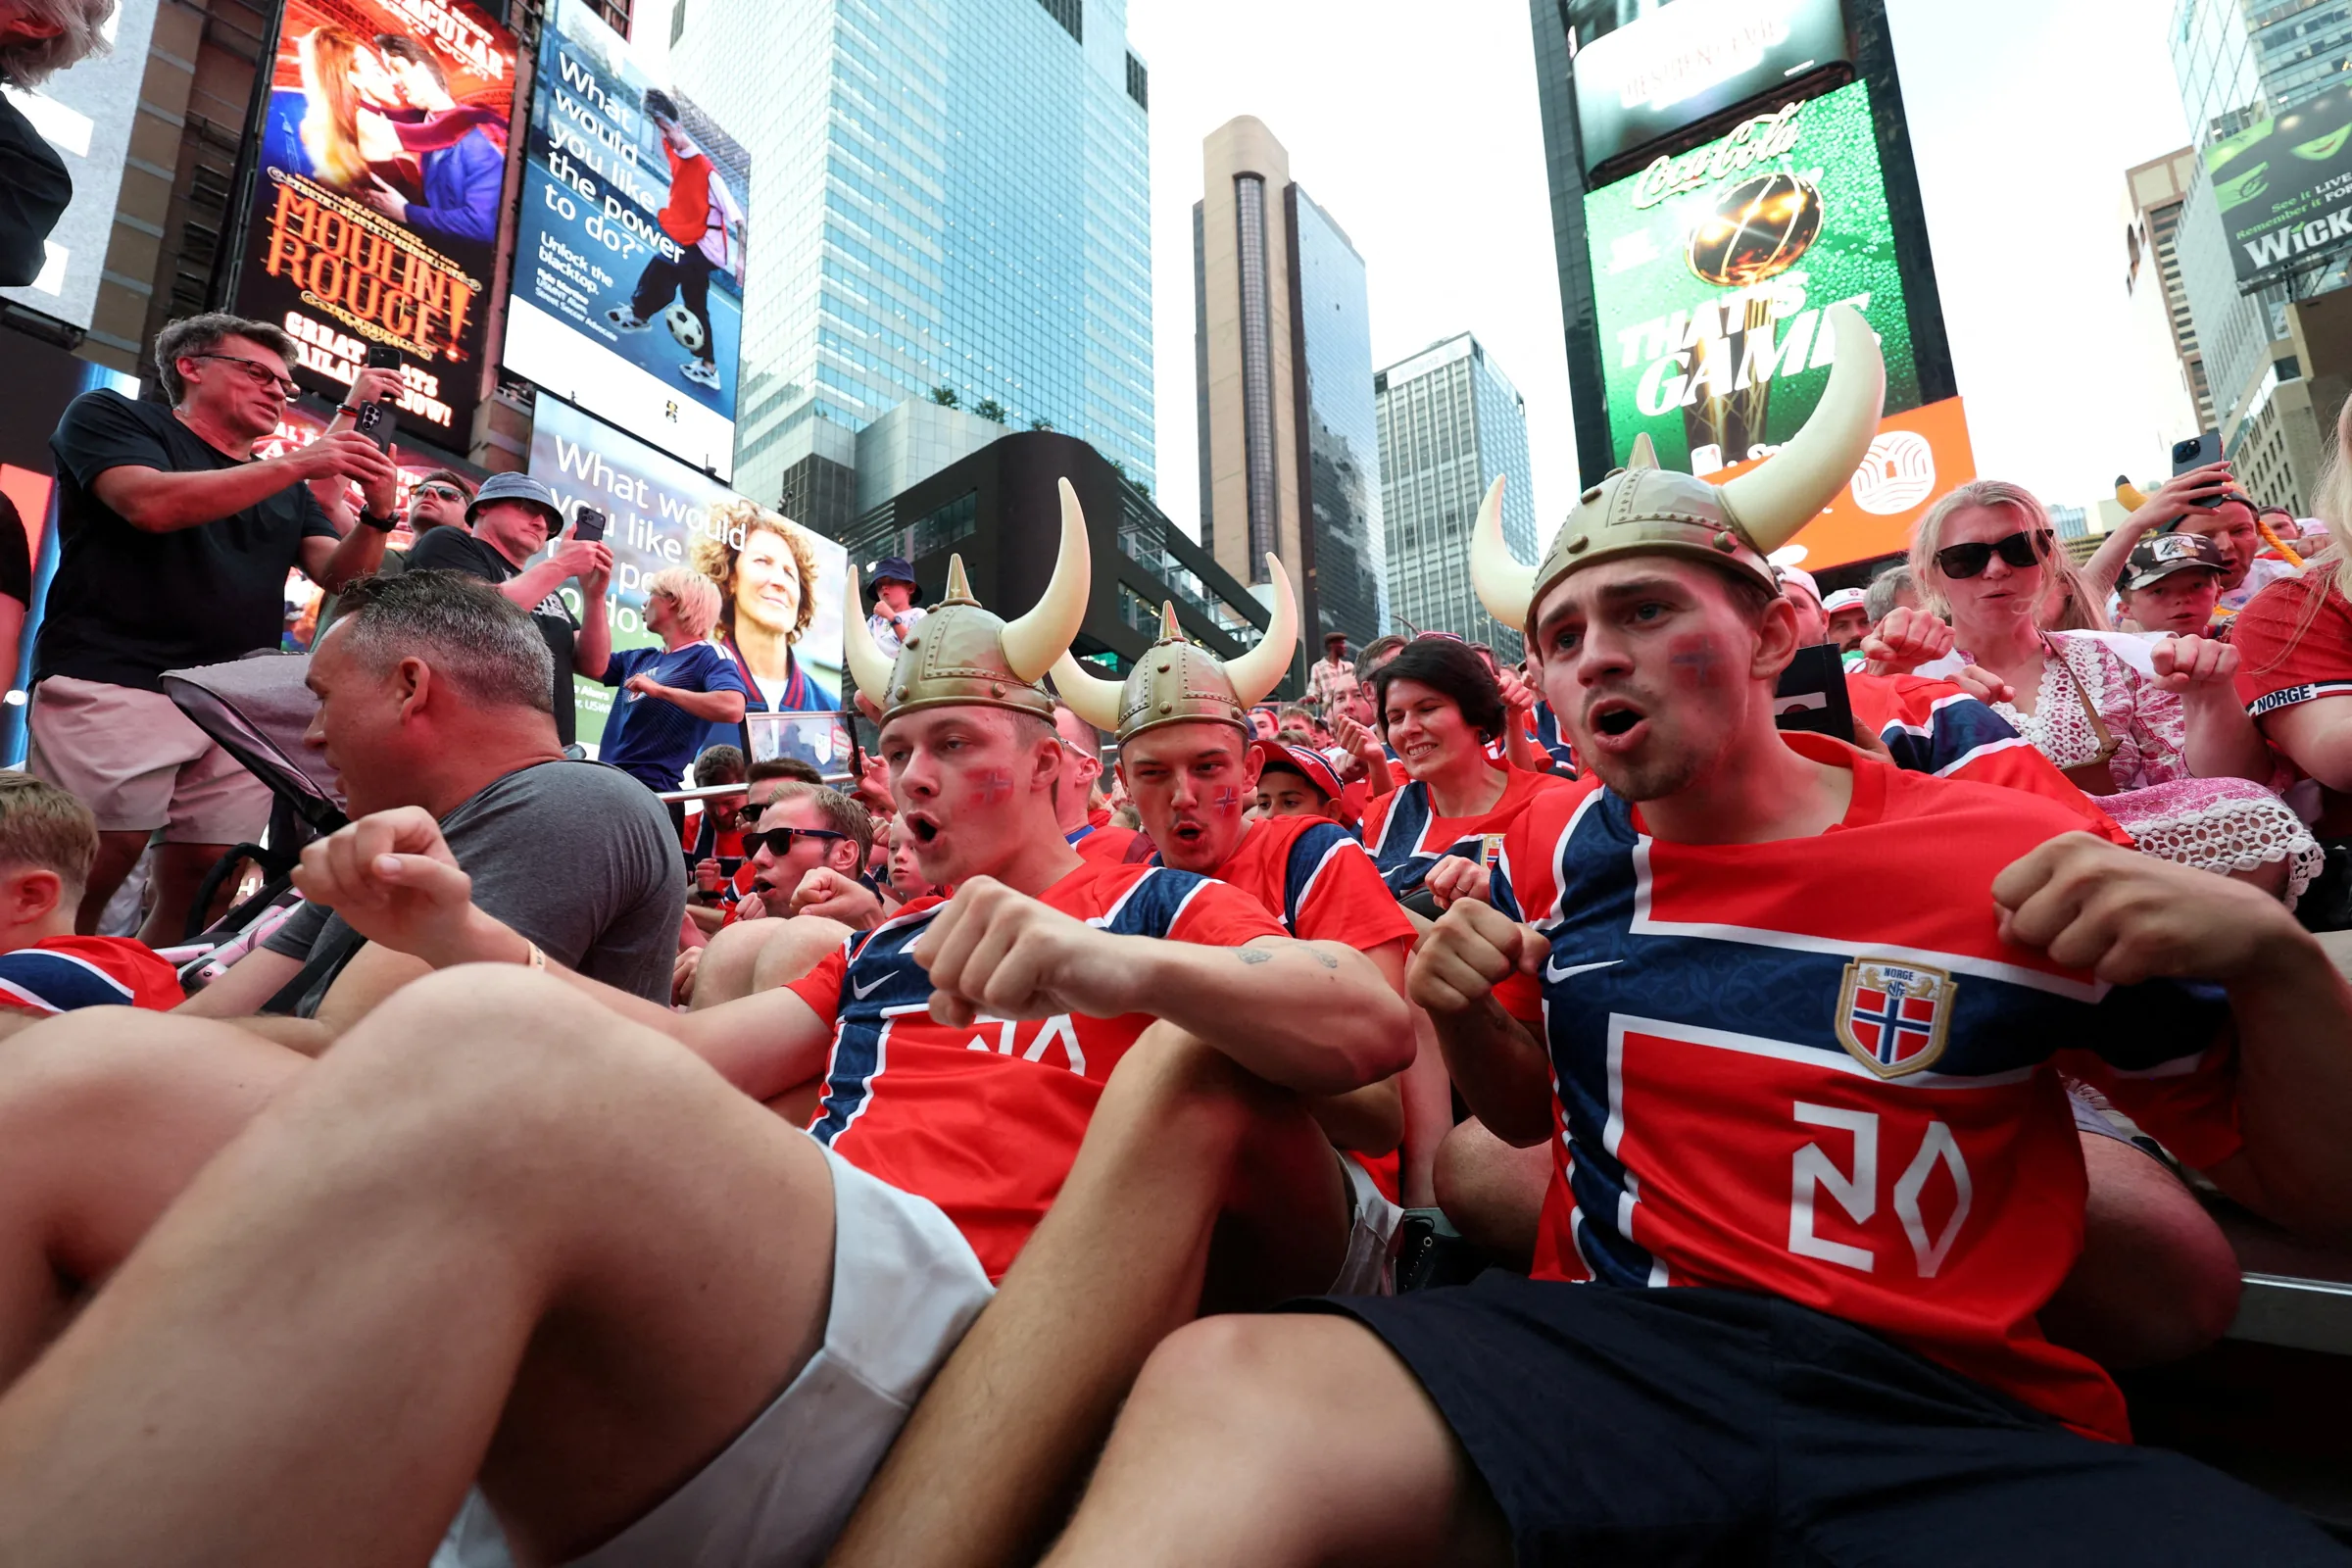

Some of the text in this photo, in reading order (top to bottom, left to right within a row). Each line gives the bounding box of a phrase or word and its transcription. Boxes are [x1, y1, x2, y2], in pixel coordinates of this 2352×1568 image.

[555, 88, 638, 168] would
[560, 51, 631, 132] What
[549, 120, 657, 213] you like
[1632, 99, 1806, 210] Coca-Cola
[545, 183, 576, 220] to
[549, 152, 686, 264] the power
[2235, 204, 2308, 240] Remember
[273, 183, 449, 319] MOULIN
[539, 245, 600, 296] blacktop.
[541, 231, 613, 288] Unlock the
[284, 312, 367, 365] GREAT
[399, 363, 438, 398] ATS
[555, 434, 747, 552] What would
[627, 513, 683, 564] like
[2257, 685, 2312, 713] NORGE
[1884, 967, 1914, 981] NORGE
[1788, 1101, 1972, 1278] 20
